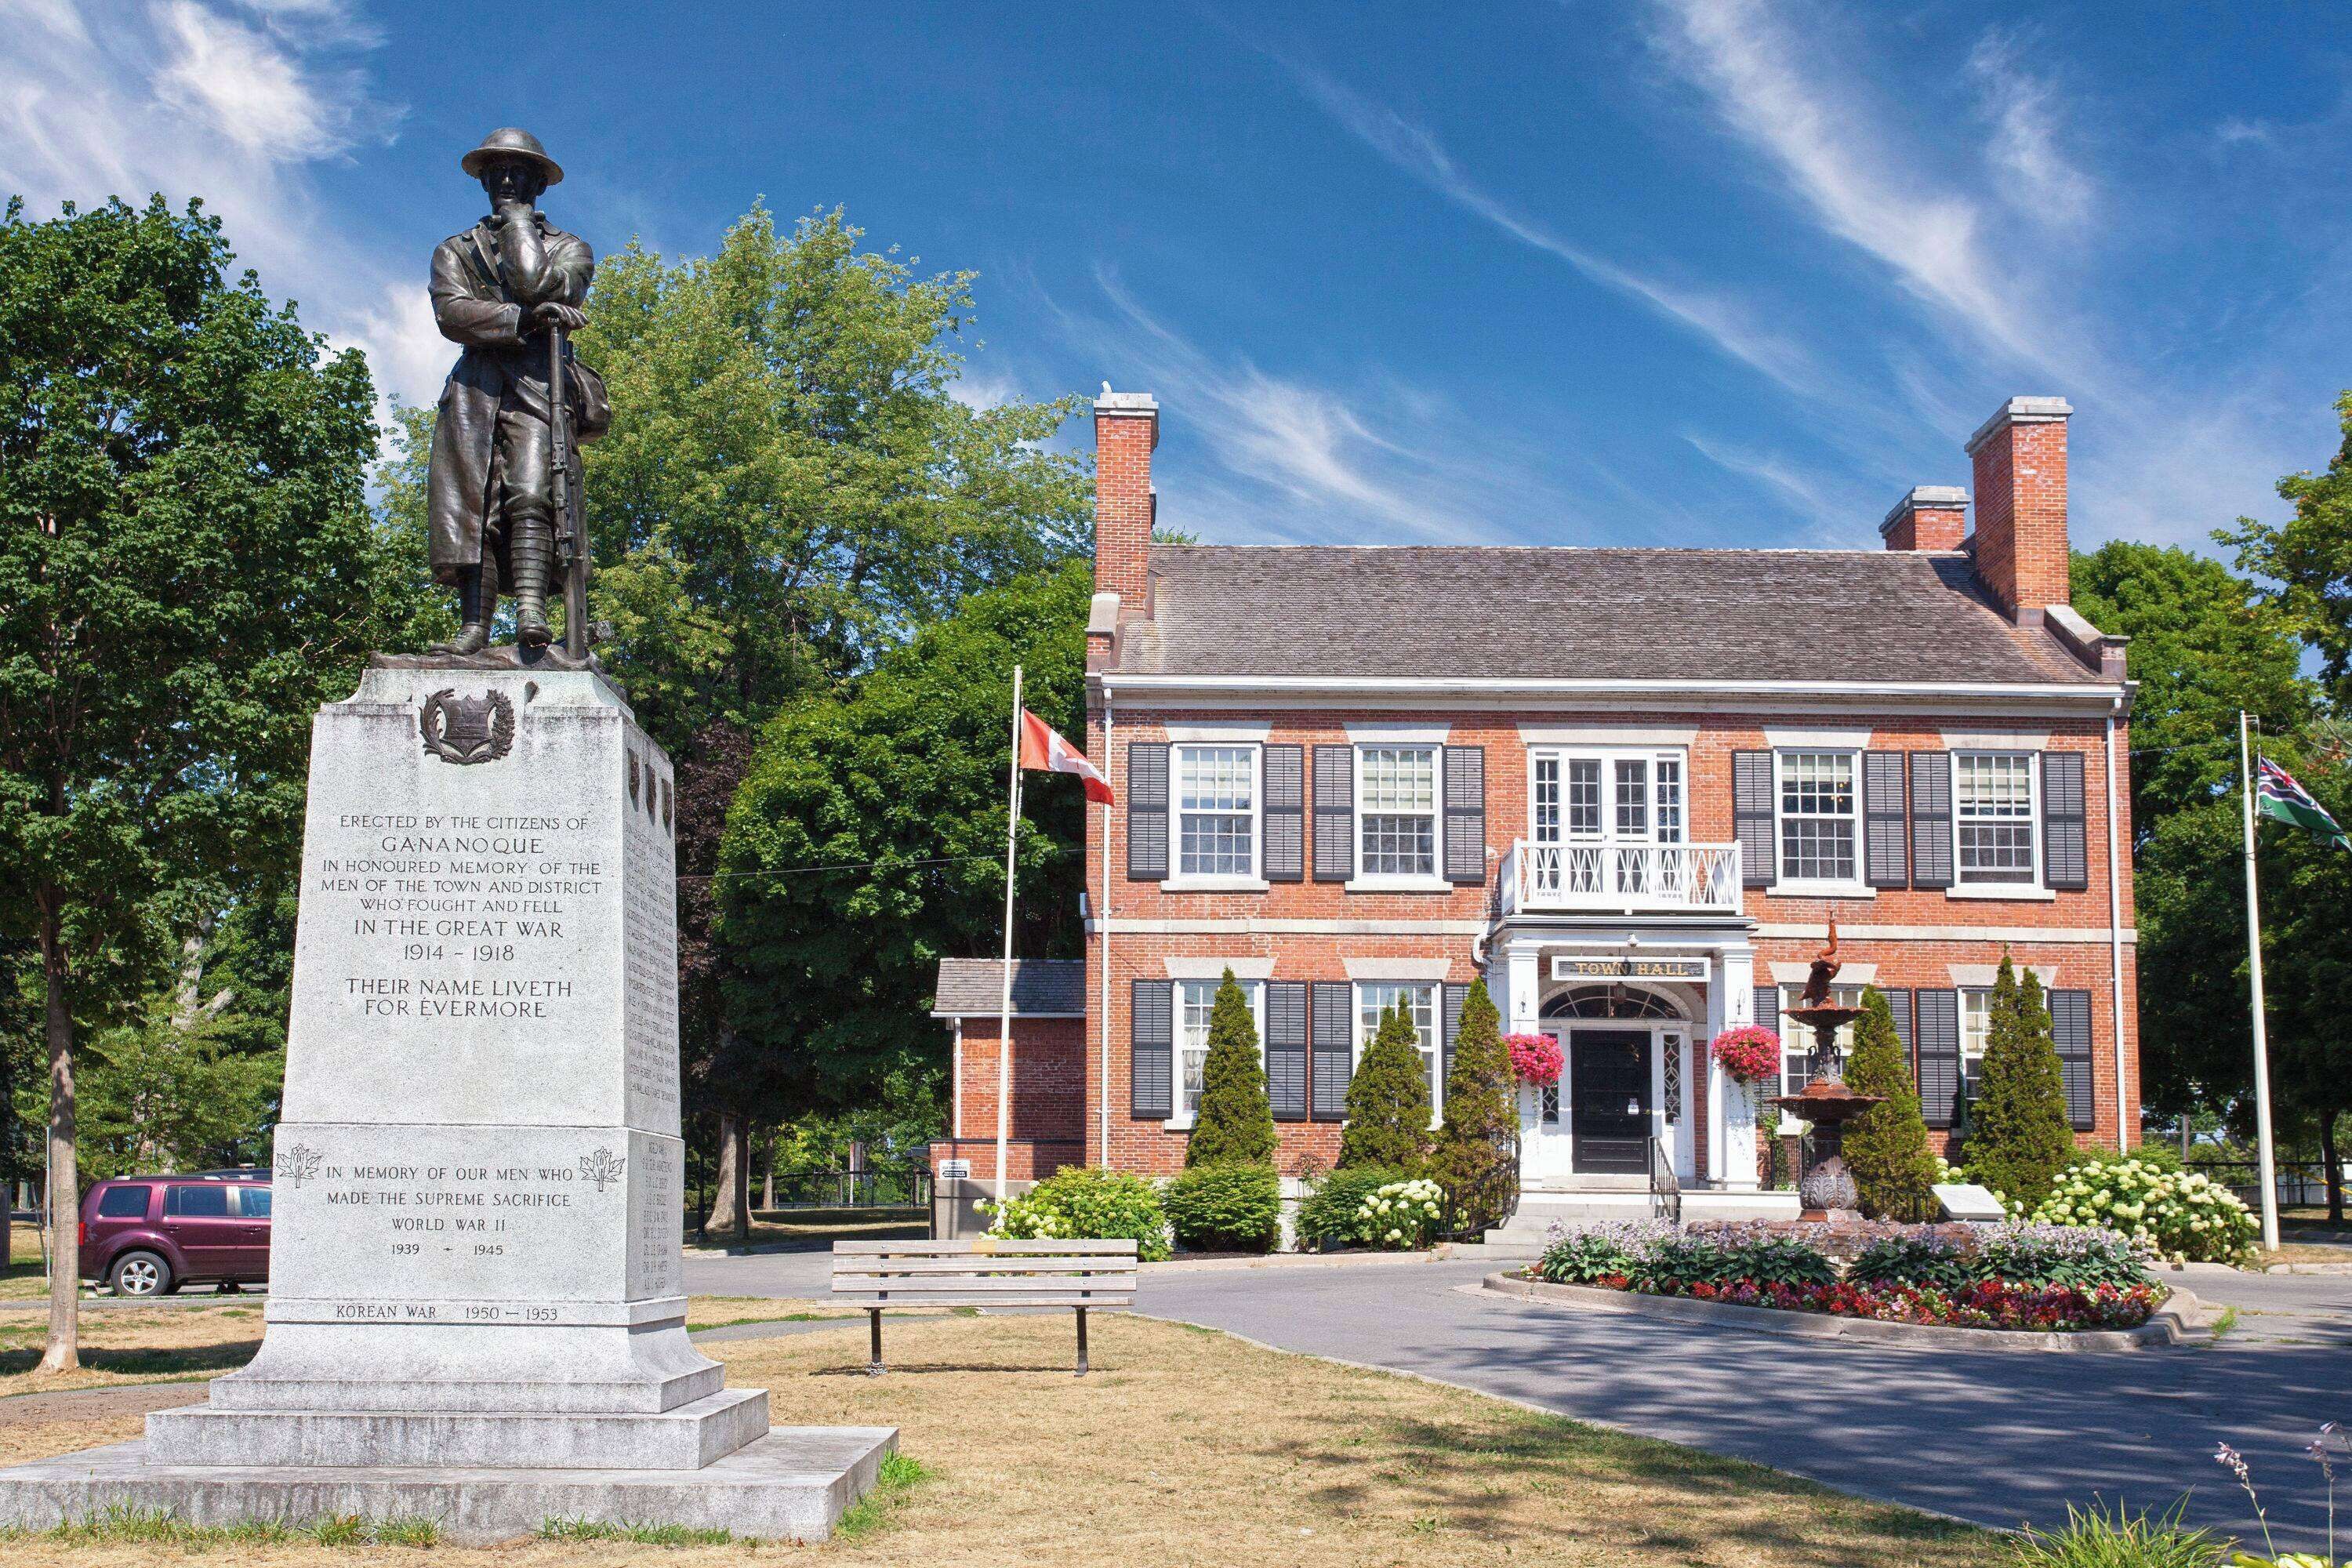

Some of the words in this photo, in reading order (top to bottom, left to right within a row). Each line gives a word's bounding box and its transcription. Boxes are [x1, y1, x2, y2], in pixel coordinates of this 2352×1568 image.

[340, 815, 417, 828] ERECTED
[425, 815, 445, 829] BY
[450, 815, 481, 829] THE
[487, 817, 560, 830] CITIZENS
[566, 817, 590, 830] OF
[381, 837, 544, 855] GANANOQUE
[323, 859, 339, 872] IN
[345, 859, 441, 873] HONOURED
[450, 861, 528, 874] MEMORY
[539, 862, 562, 875] OF
[568, 862, 601, 875] THE
[321, 879, 359, 892] MEN
[365, 879, 387, 892] OF
[394, 880, 427, 892] THE
[433, 880, 481, 893] TOWN
[488, 881, 523, 894] AND
[528, 881, 602, 895] DISTRICT
[360, 898, 401, 911] WHO
[408, 898, 477, 912] FOUGHT
[481, 900, 518, 913] AND
[523, 900, 563, 913] FELL
[354, 919, 376, 935] IN
[383, 919, 430, 936] THE
[436, 920, 508, 937] GREAT
[516, 920, 564, 938] WAR
[404, 944, 444, 961] 1914
[472, 944, 514, 962] 1918
[1573, 962, 1628, 977] TOWN
[1636, 963, 1689, 976] HALL
[345, 978, 411, 995] THEIR
[419, 979, 485, 996] NAME
[492, 980, 572, 997] LIVETH
[365, 999, 411, 1016] FOR
[419, 1000, 548, 1018] EVERMORE
[326, 1166, 342, 1179] IN
[354, 1166, 419, 1180] MEMORY
[426, 1167, 448, 1180] OF
[456, 1167, 488, 1181] OUR
[495, 1168, 528, 1181] MEN
[538, 1168, 573, 1181] WHO
[327, 1192, 370, 1205] MADE
[377, 1192, 408, 1206] THE
[415, 1192, 485, 1206] SUPREME
[492, 1193, 572, 1207] SACRIFICE
[391, 1218, 445, 1231] WORLD
[455, 1218, 486, 1232] WAR
[495, 1218, 506, 1232] II
[390, 1243, 420, 1255] 1939
[474, 1244, 504, 1256] 1945
[336, 1305, 397, 1319] KOREAN
[406, 1305, 437, 1319] WAR
[465, 1306, 500, 1319] 1950
[525, 1308, 558, 1321] 1953
